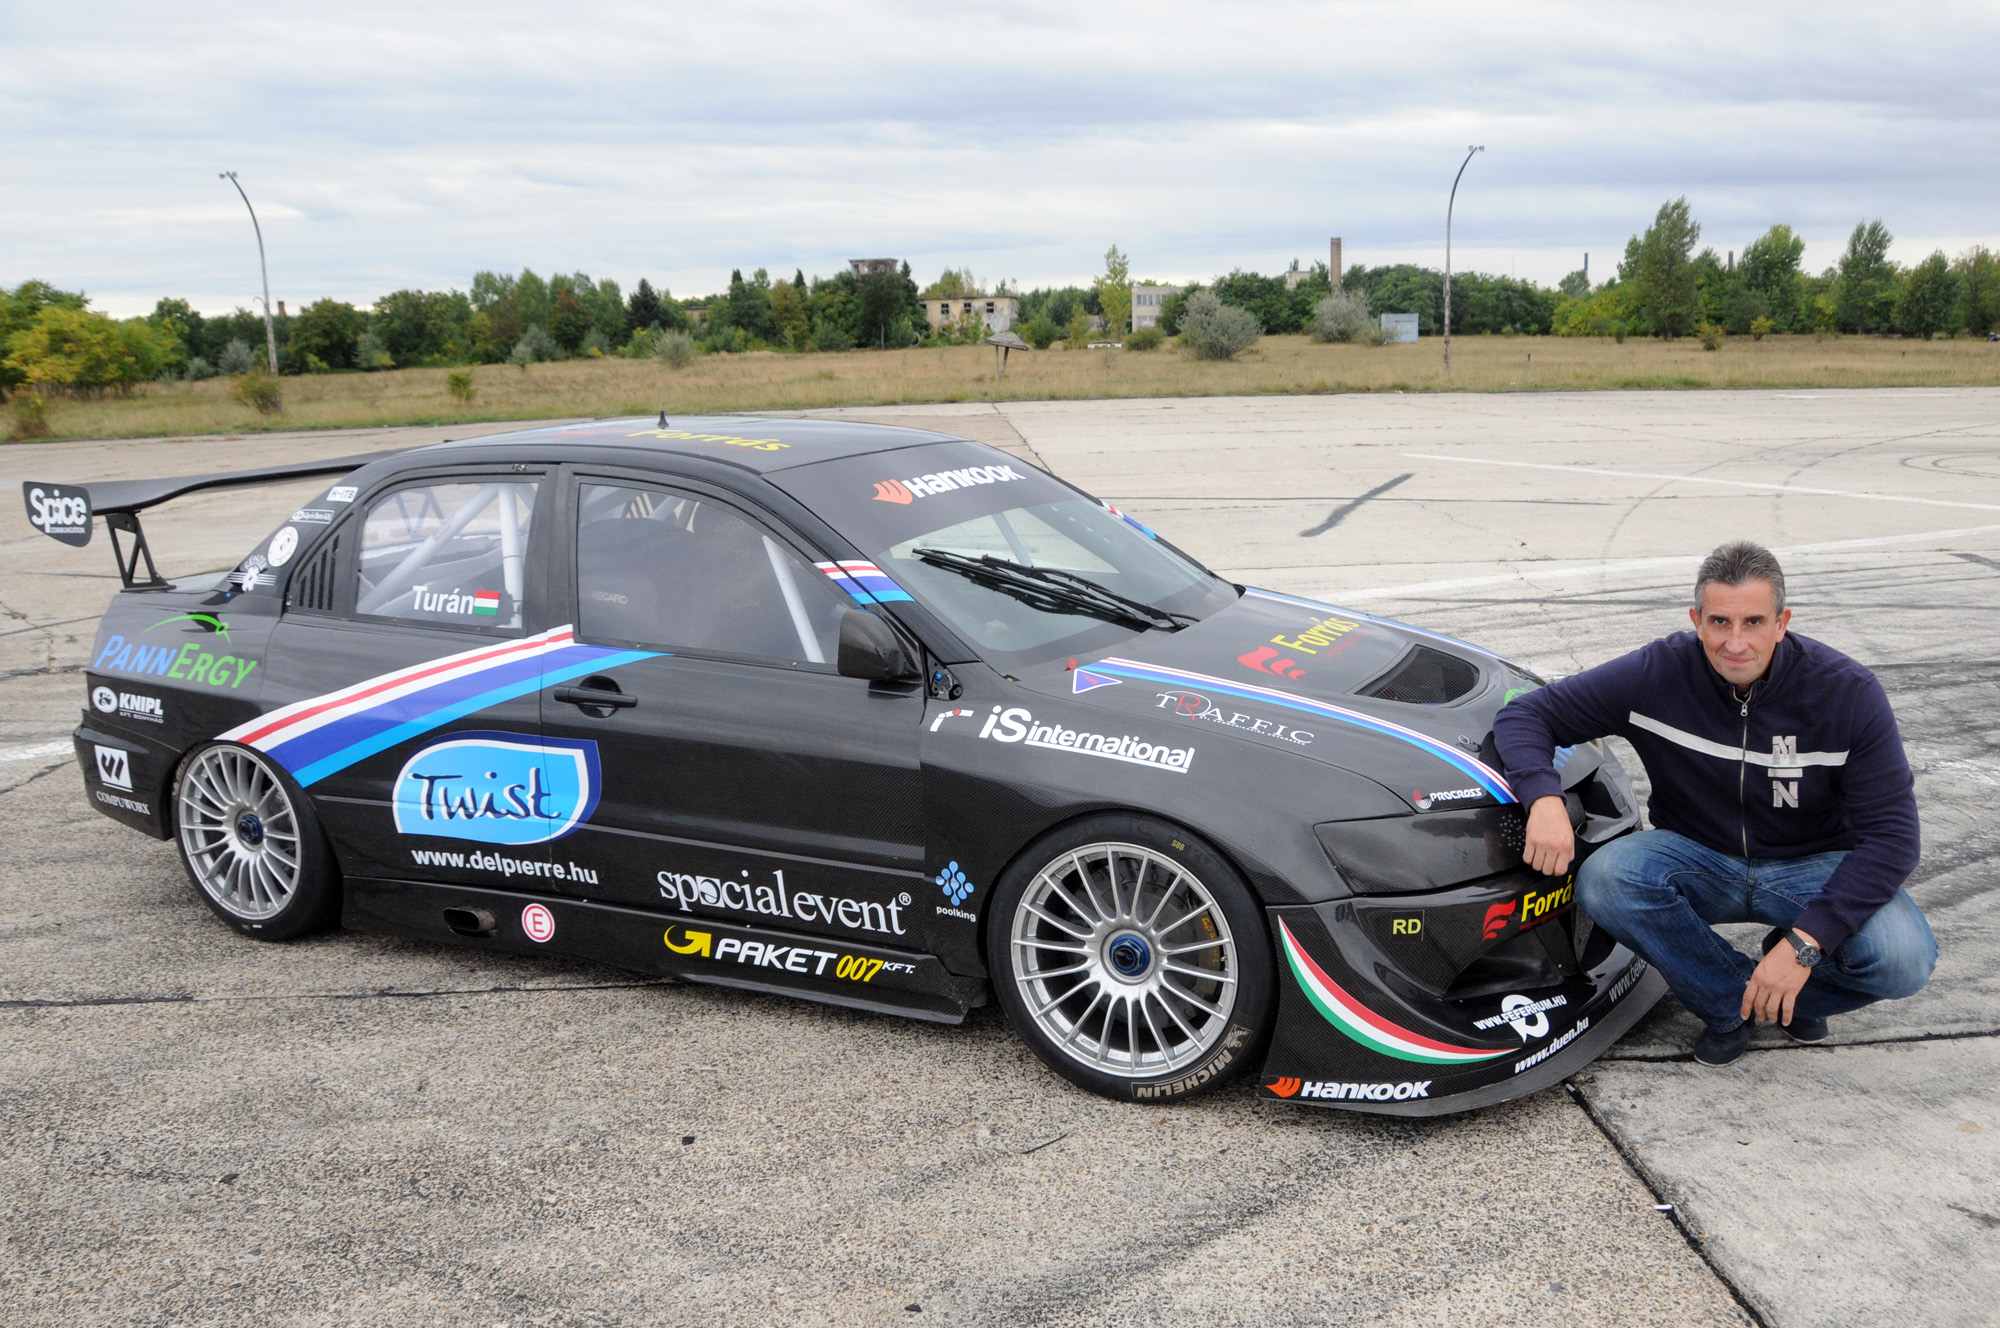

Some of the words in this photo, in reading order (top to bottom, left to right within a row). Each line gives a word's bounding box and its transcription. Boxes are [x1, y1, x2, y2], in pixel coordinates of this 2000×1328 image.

[627, 429, 791, 451] Forrás
[901, 465, 1026, 498] Hankook
[30, 488, 87, 533] Spice
[412, 585, 474, 615] Turán
[591, 591, 629, 605] RECARO
[1270, 617, 1360, 655] Forrás
[118, 692, 164, 716] KNIPL
[1155, 691, 1316, 745] TRAFFIC
[96, 791, 151, 815] COMPUWORX
[407, 767, 562, 820] Twist
[1430, 787, 1483, 802] PROCROSS
[411, 850, 599, 885] www.delpierre.hu
[936, 905, 976, 923] poolking
[1520, 874, 1572, 922] Forrá
[1392, 918, 1422, 935] RD
[715, 938, 837, 975] PAKET
[835, 954, 884, 982] 007
[882, 961, 916, 974] KFT.
[1473, 994, 1568, 1031] WWW.FEFERRUM.HU
[1514, 1016, 1590, 1075] www.duen.hu
[1136, 1048, 1233, 1099] MICHELIN
[1300, 1080, 1433, 1101] Hankook
